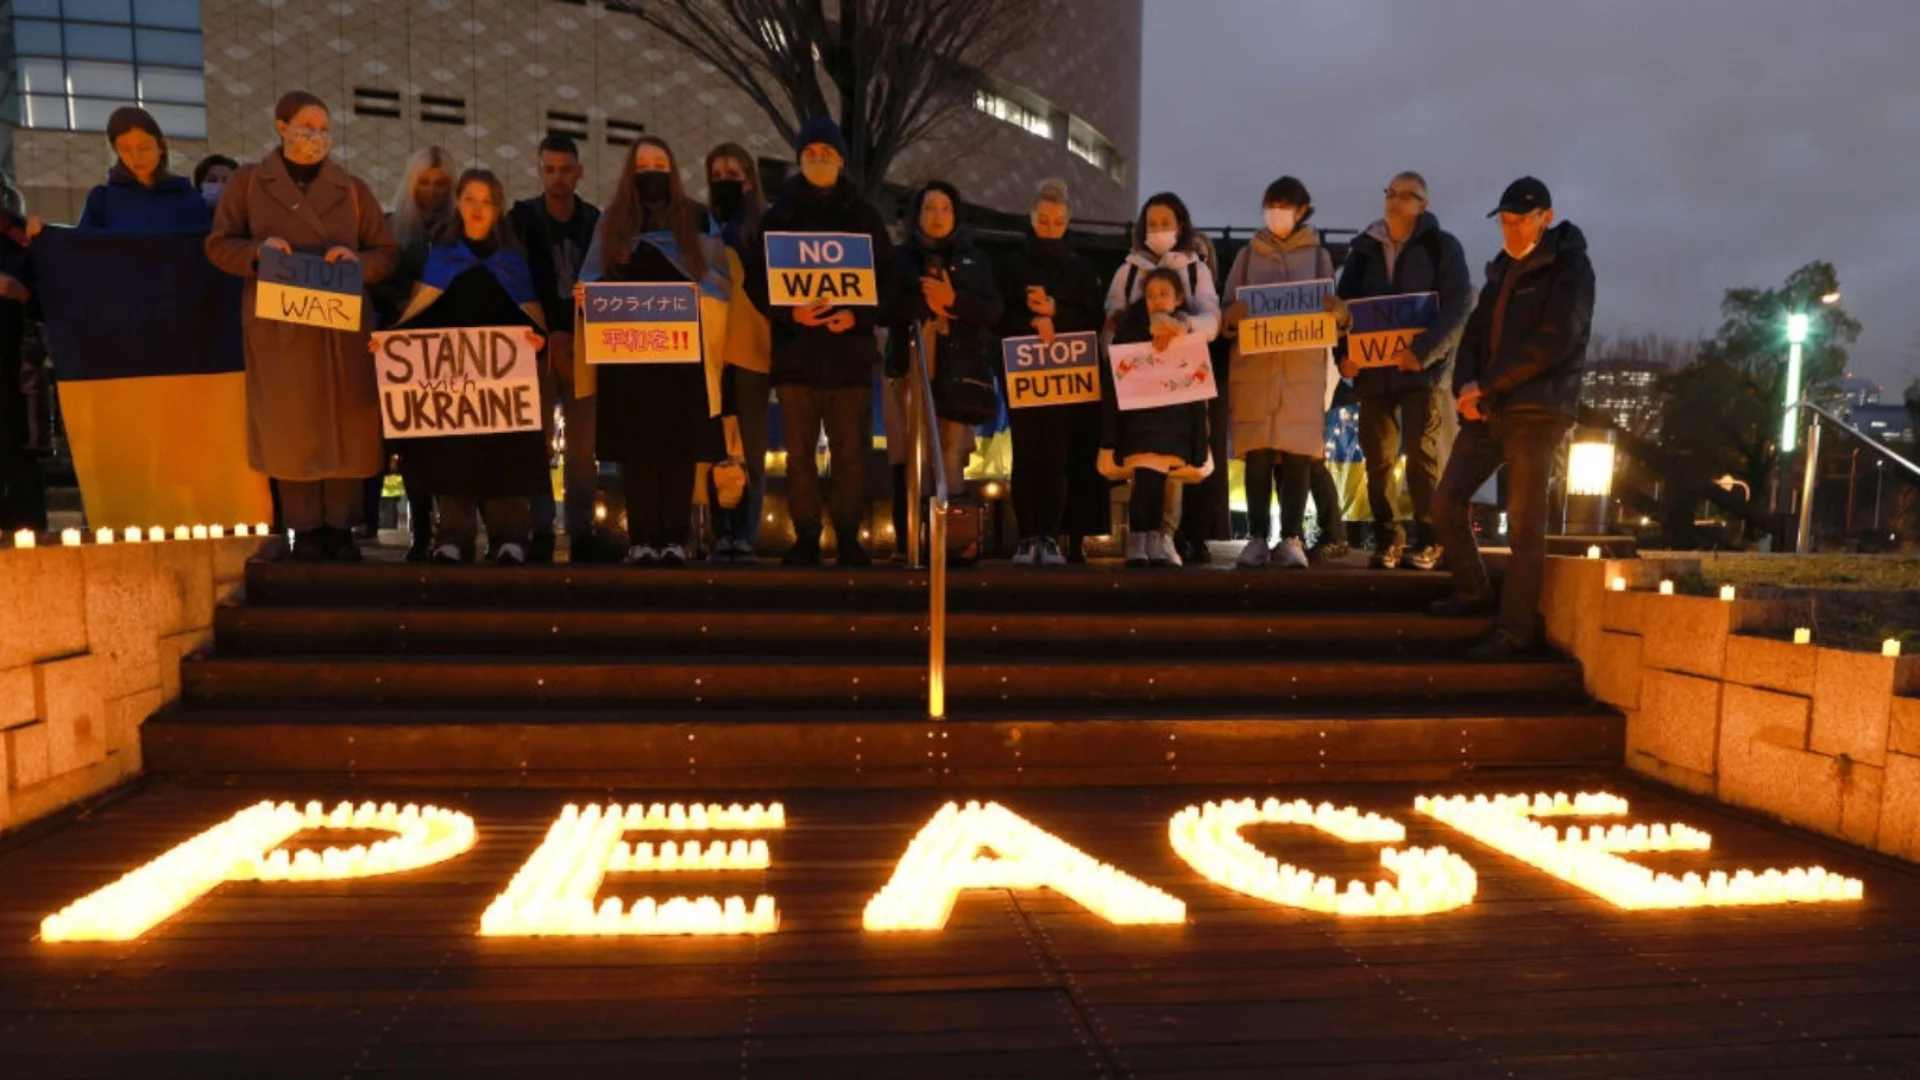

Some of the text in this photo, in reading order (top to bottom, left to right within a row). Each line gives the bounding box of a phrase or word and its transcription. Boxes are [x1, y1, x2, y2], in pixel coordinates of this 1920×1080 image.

[798, 240, 844, 264] NO
[276, 256, 358, 287] STOP
[781, 272, 863, 298] WAR
[280, 291, 351, 325] WAR
[592, 296, 688, 312] ウクライナに
[1372, 303, 1417, 328] NO
[1288, 319, 1324, 343] child
[383, 330, 517, 384] STAND
[1016, 340, 1087, 367] STOP
[1360, 335, 1408, 361] WA
[418, 372, 477, 394] with
[1014, 372, 1093, 399] PUTIN
[384, 385, 534, 432] UKRAINE
[40, 792, 1864, 943] PEACE
